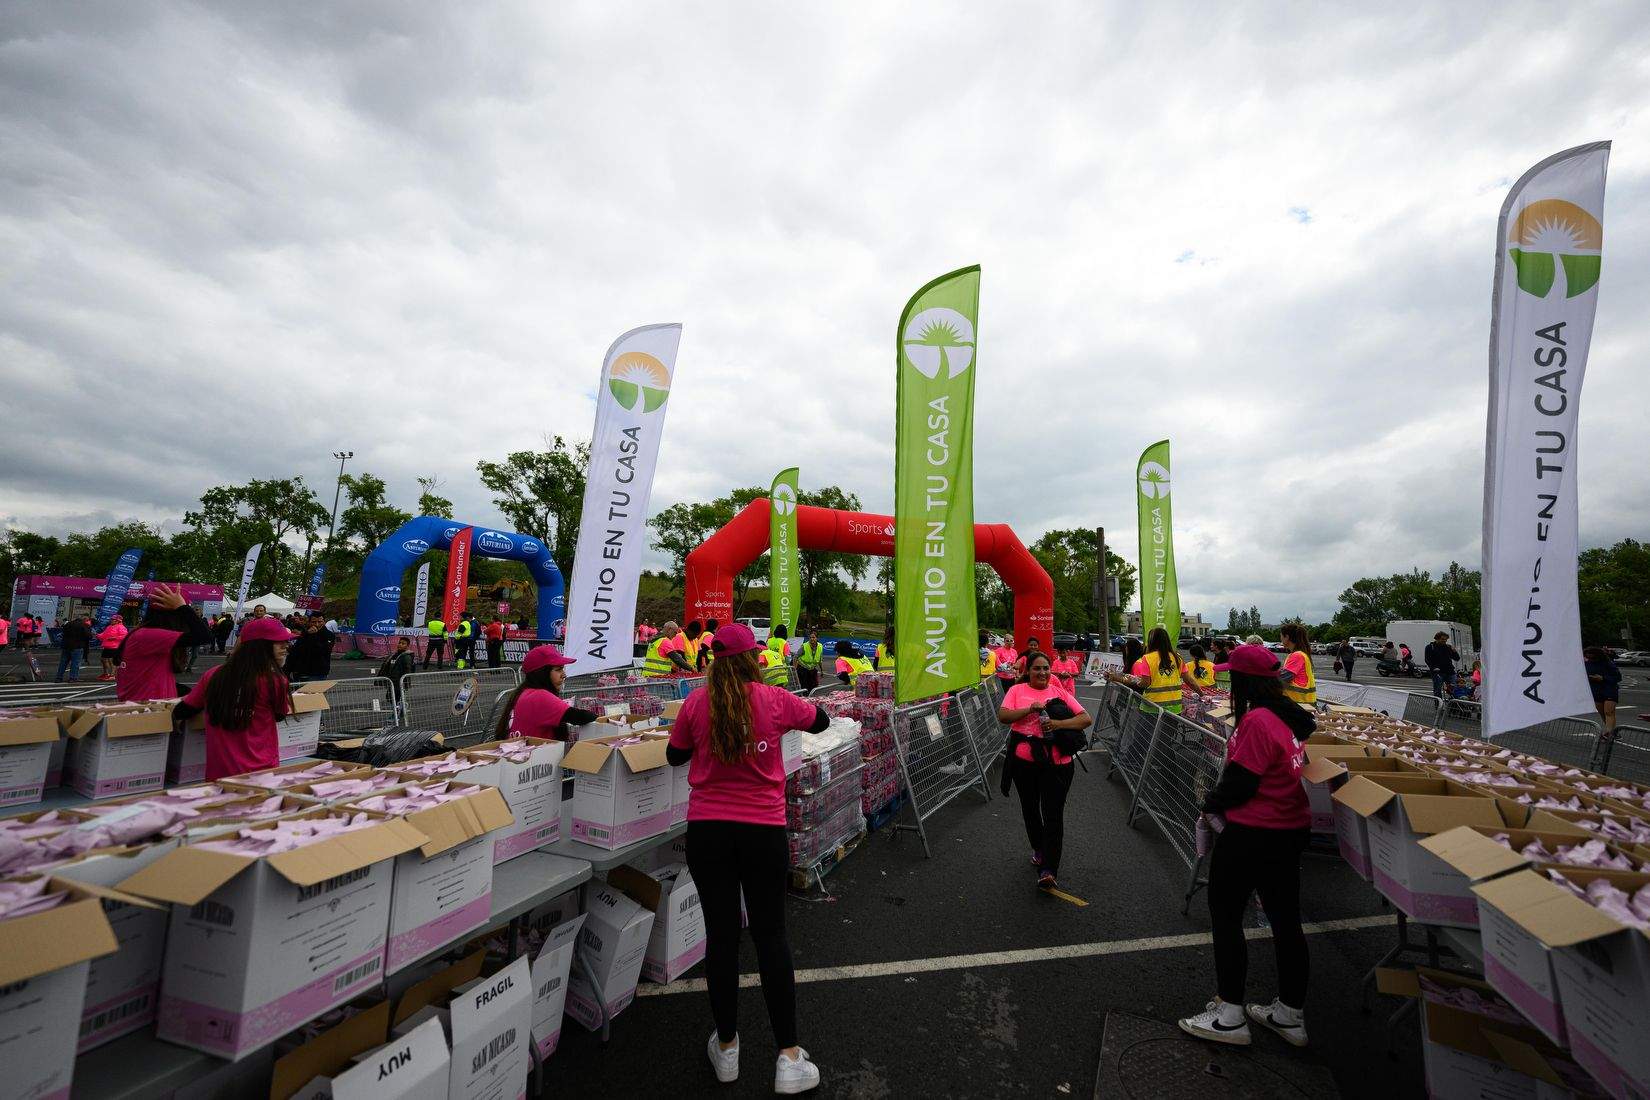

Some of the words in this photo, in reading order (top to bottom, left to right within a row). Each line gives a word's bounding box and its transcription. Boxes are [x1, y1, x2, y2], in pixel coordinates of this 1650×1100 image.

[1534, 321, 1566, 418] CASA
[926, 395, 950, 466] CASA
[615, 426, 642, 485] CASA
[1536, 429, 1566, 486] TU
[608, 491, 632, 521] TU
[926, 475, 948, 512] TU
[780, 522, 788, 553] CASA
[848, 520, 883, 535] Sports
[925, 521, 945, 557] EN
[1152, 507, 1164, 544] CASA
[603, 529, 625, 560] EN
[1155, 548, 1166, 568] TU
[450, 598, 460, 626] Sports
[455, 540, 466, 585] Santander
[780, 558, 788, 573] TU
[1156, 573, 1165, 592] EN
[416, 572, 427, 615] OYSHO
[780, 577, 789, 593] EN
[588, 567, 616, 660] AMUTIO
[924, 568, 948, 678] AMUTIO
[518, 766, 530, 785] SAN
[596, 890, 618, 908] MUY
[475, 976, 514, 1010] FRAGIL
[378, 1046, 412, 1082] MUY
[472, 1046, 487, 1074] SAN
[488, 1028, 516, 1062] NICASIO
